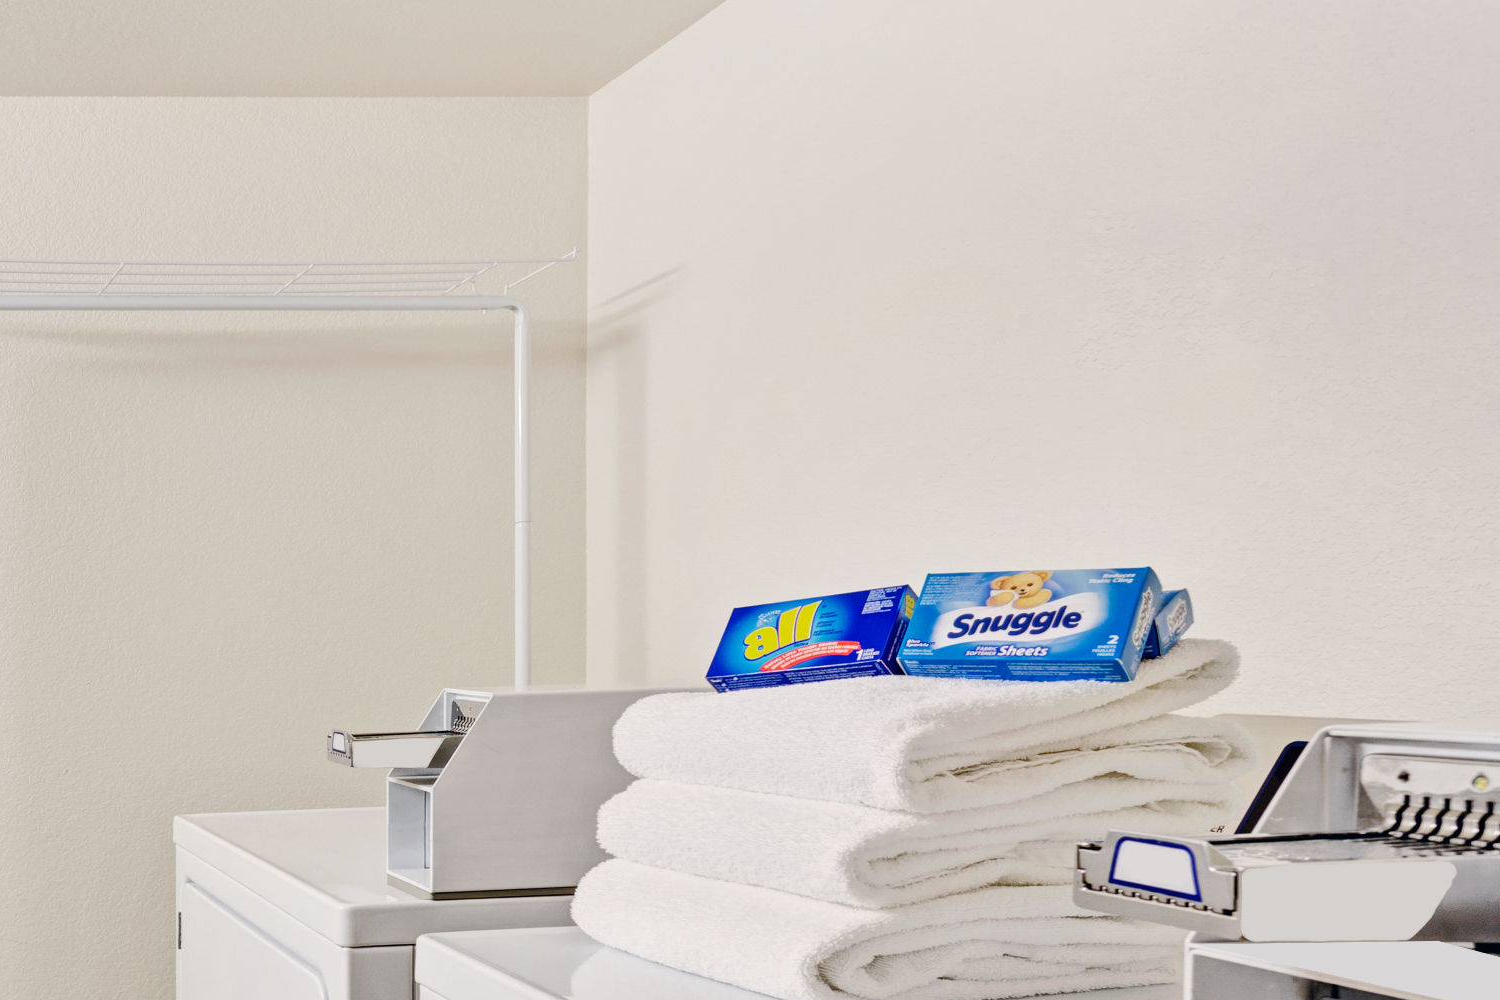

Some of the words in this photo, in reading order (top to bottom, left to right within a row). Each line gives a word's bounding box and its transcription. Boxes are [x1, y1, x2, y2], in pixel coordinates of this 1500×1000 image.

[946, 605, 1082, 639] Snuggle
[743, 600, 823, 661] all
[1106, 635, 1120, 644] 2
[856, 648, 864, 660] 1
[997, 645, 1049, 657] Sheets
